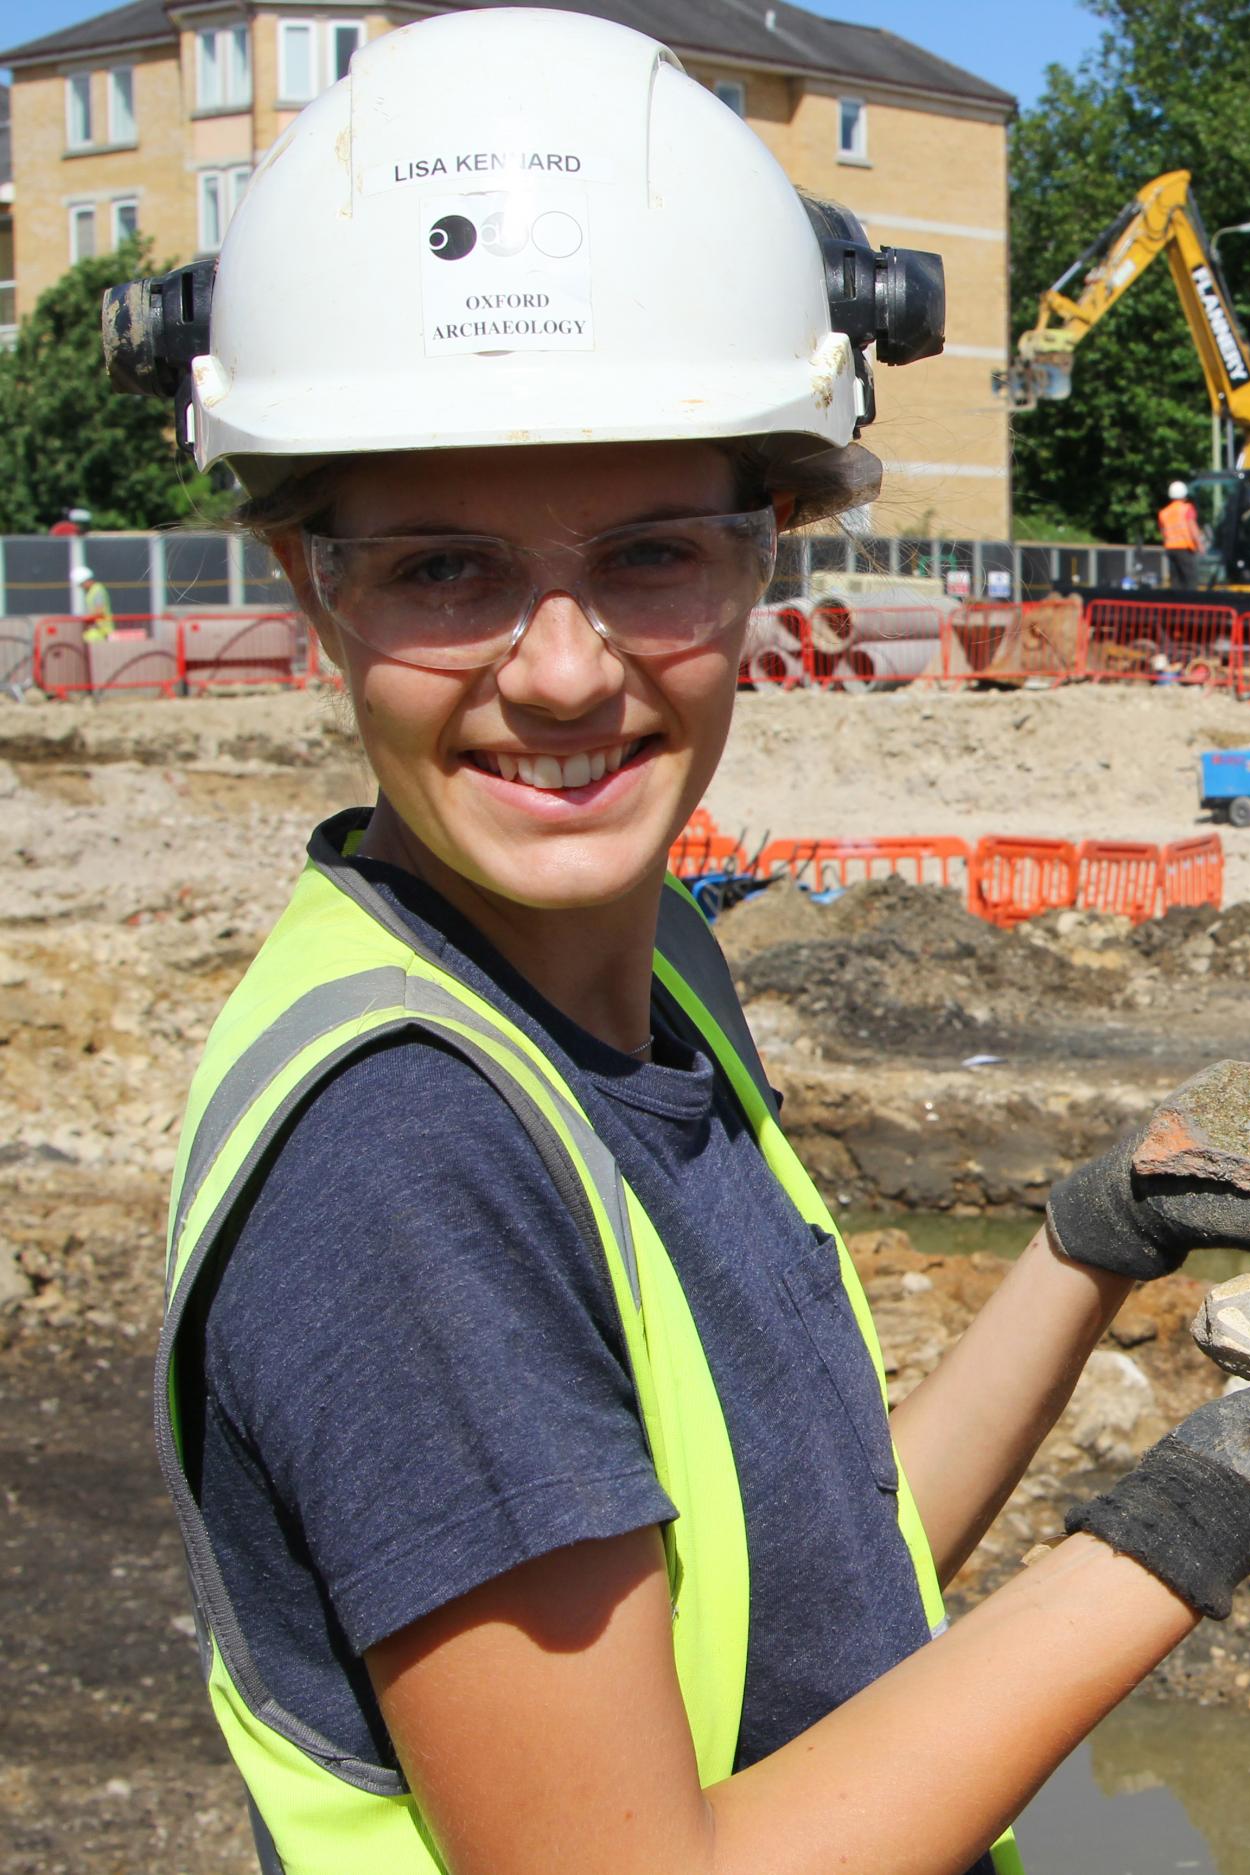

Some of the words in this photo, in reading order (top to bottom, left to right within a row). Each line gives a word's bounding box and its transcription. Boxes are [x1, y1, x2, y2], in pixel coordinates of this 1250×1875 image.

[394, 158, 448, 182] LISA
[465, 293, 550, 310] OXFORD
[432, 318, 587, 341] ARCHAEOLOGY
[1191, 265, 1249, 380] FLANNERY
